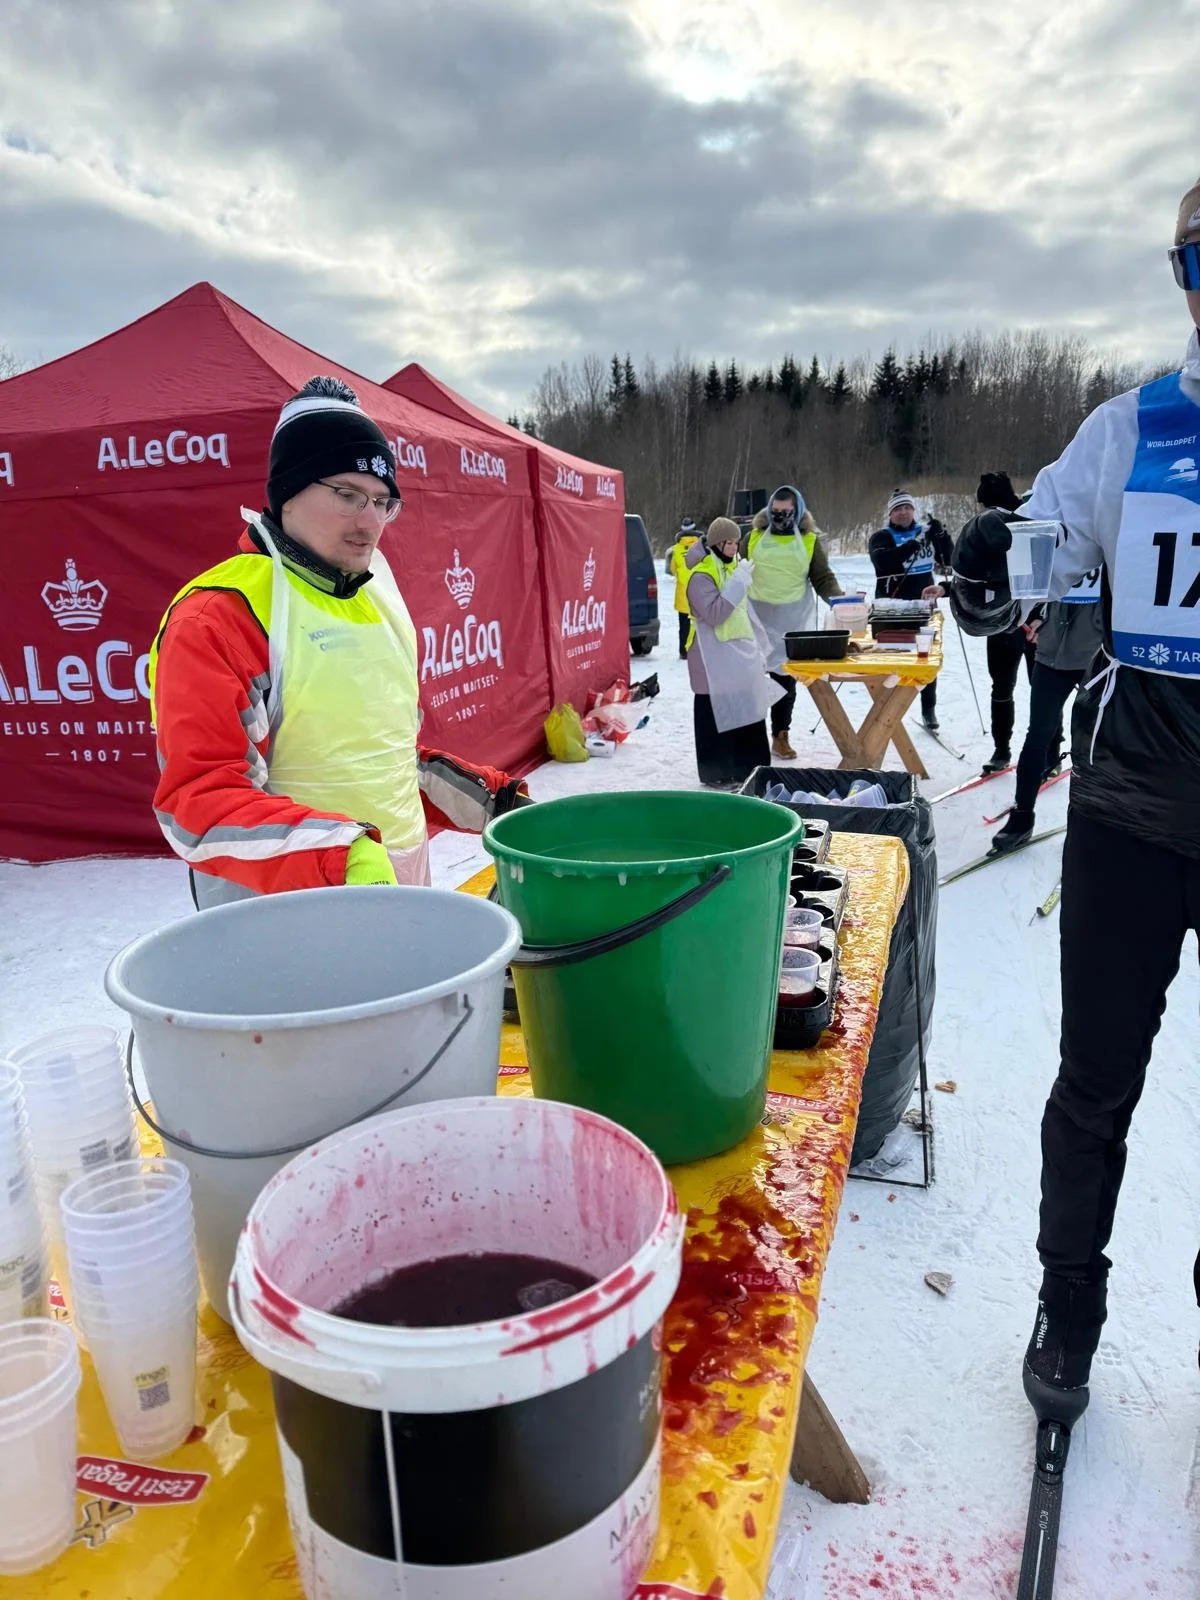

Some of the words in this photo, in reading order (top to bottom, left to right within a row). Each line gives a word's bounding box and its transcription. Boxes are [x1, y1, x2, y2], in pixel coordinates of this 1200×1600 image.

[1146, 435, 1197, 448] WORLDLOPPET
[97, 430, 230, 471] A.LeCoq
[356, 460, 368, 470] 50
[460, 448, 507, 485] A.LeCoq
[561, 595, 606, 639] A.LeCoq
[421, 615, 504, 684] A.LeCoq
[1131, 646, 1145, 658] 52
[4, 722, 49, 735] ELUS
[60, 722, 85, 735] ON
[71, 750, 121, 761] 1807
[134, 1476, 196, 1498] Eesti
